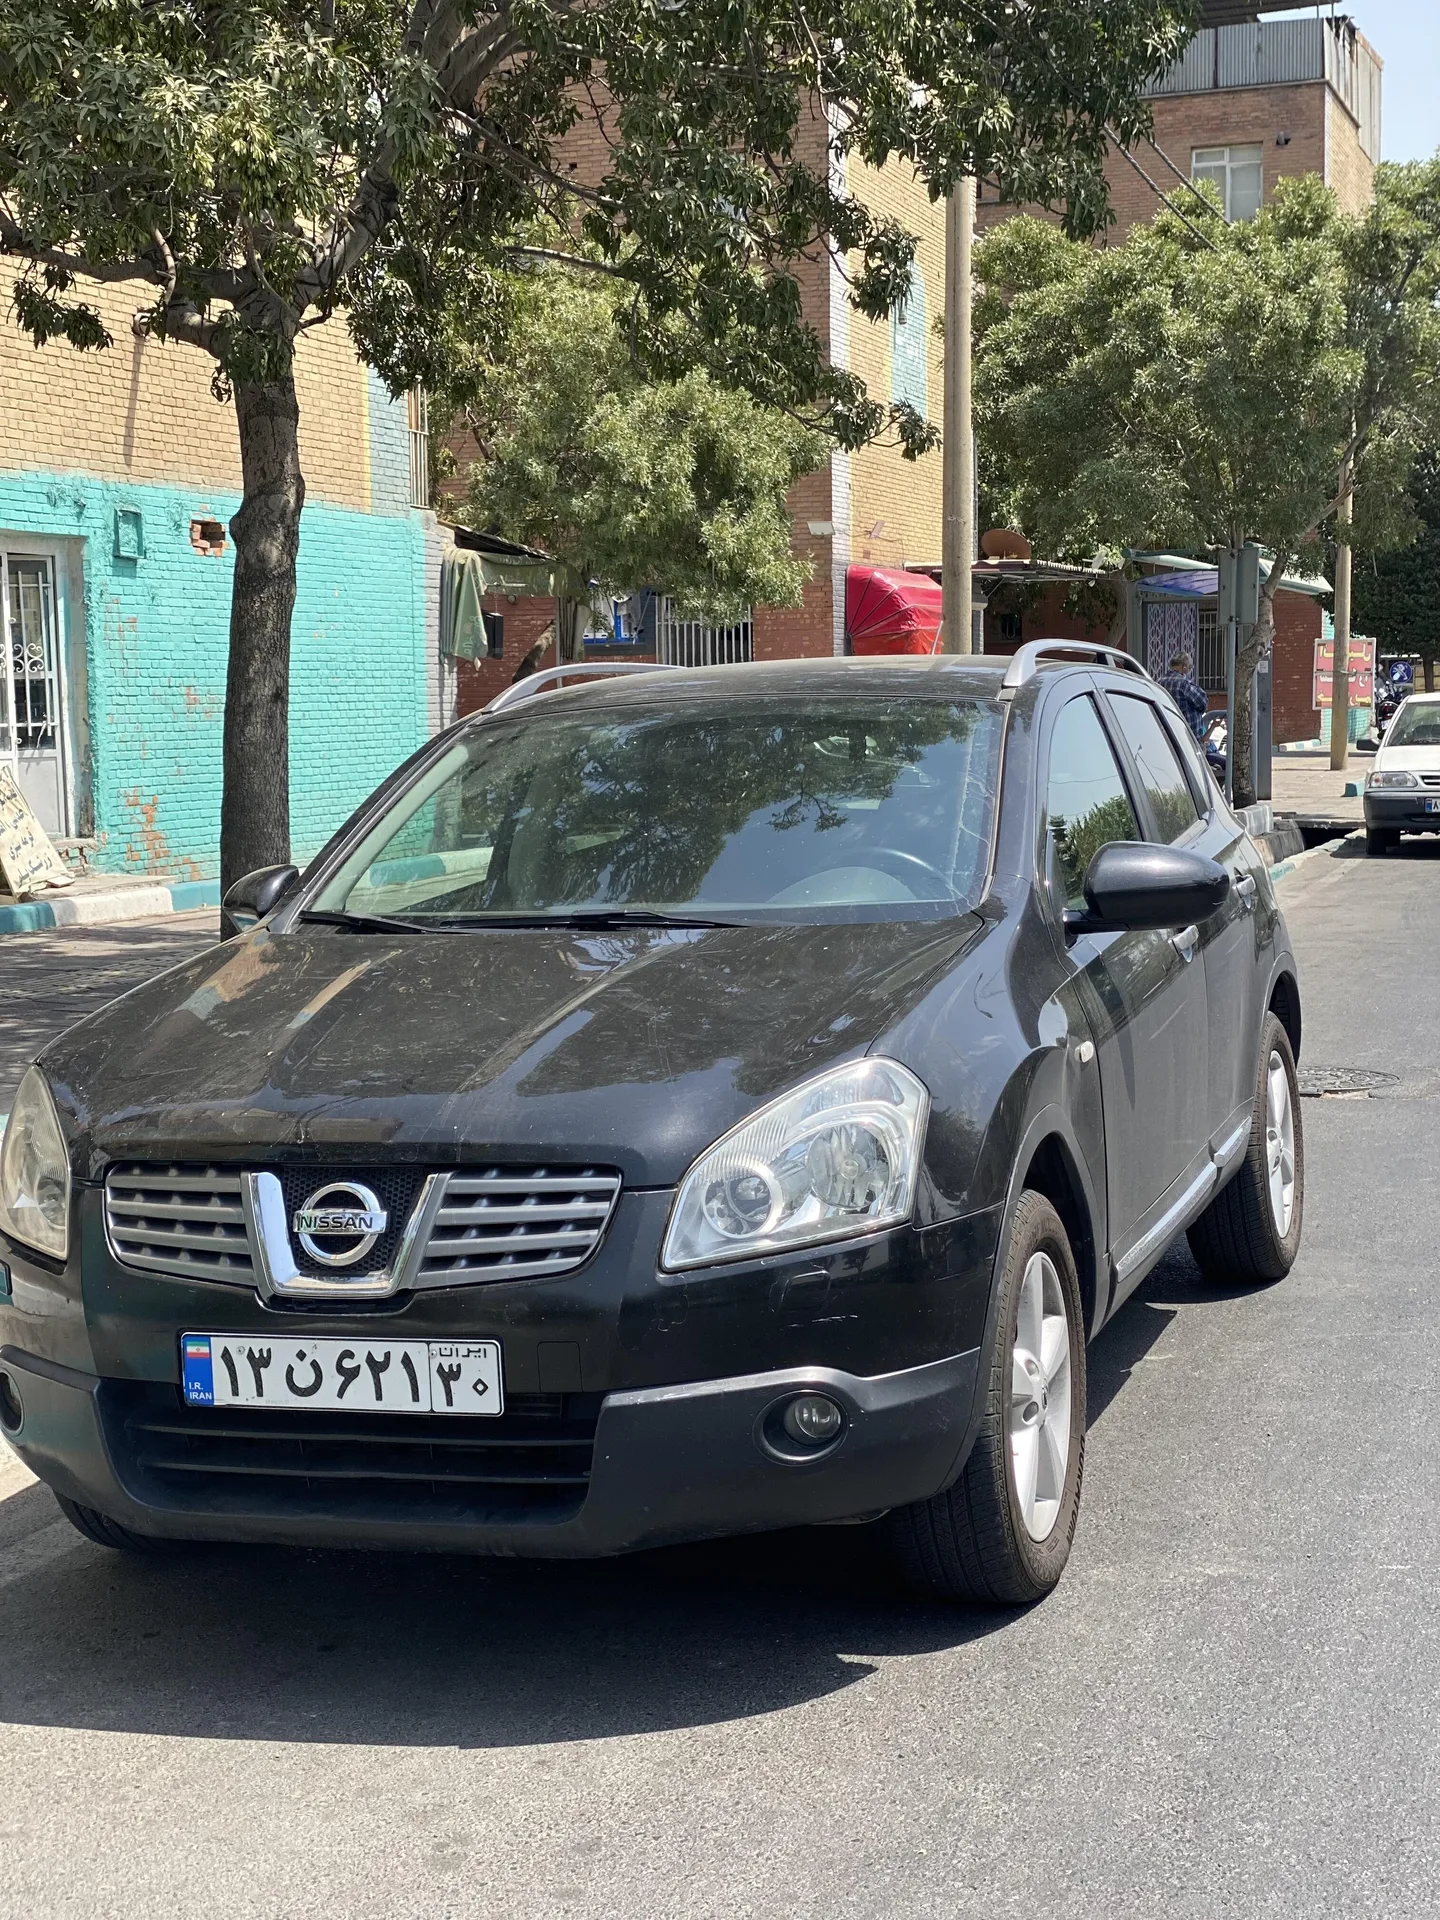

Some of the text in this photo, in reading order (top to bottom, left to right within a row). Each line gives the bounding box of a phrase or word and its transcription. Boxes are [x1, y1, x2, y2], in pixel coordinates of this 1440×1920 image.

[300, 1216, 373, 1229] NISSAN
[439, 1347, 487, 1358] ایران
[188, 1381, 204, 1390] I.R.
[436, 1361, 489, 1407] ۳۰
[190, 1391, 213, 1400] IRAN
